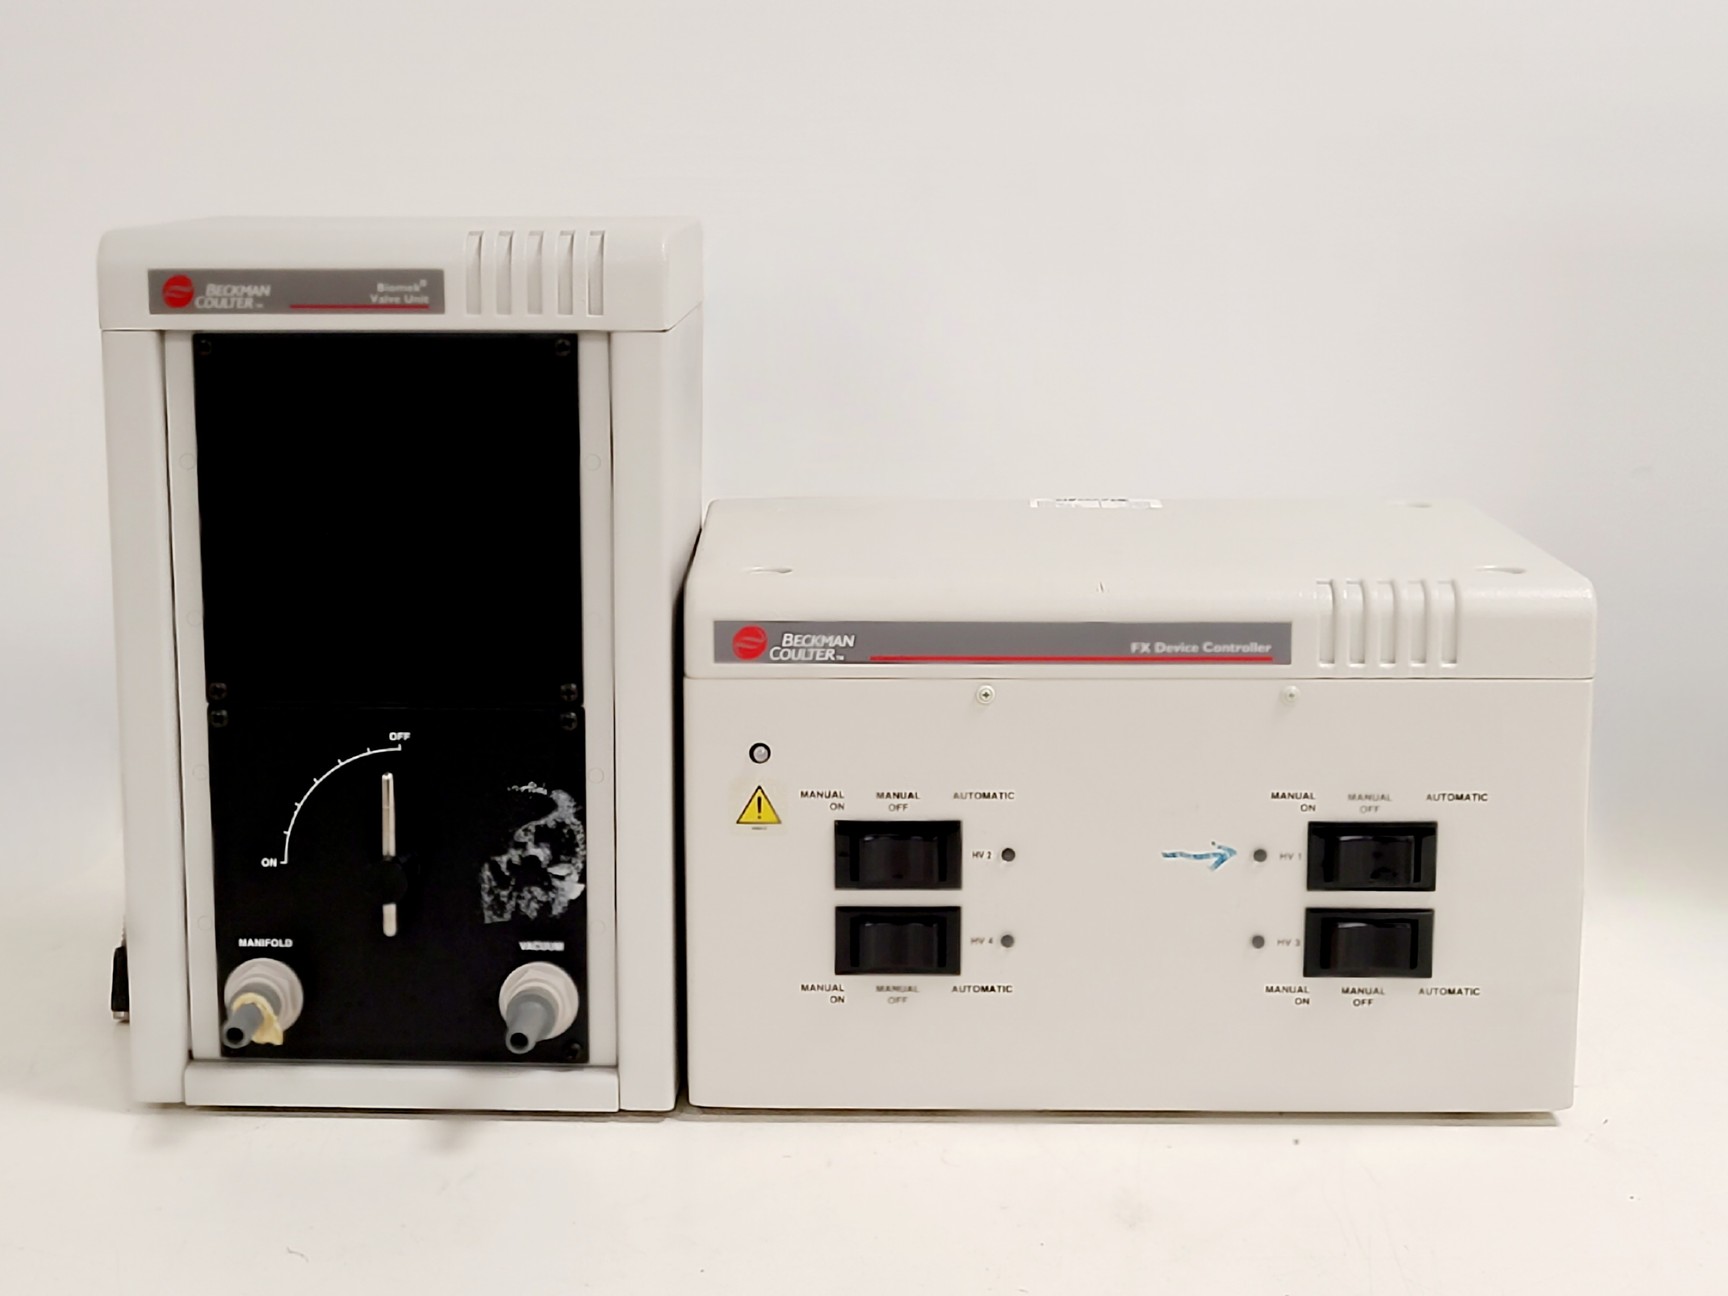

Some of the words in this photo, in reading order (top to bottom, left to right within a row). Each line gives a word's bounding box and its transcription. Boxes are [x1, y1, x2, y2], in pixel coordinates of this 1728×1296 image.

[205, 283, 271, 297] BECKMAN
[369, 294, 401, 304] Valve
[404, 294, 430, 305] Unit
[781, 633, 855, 647] BECKMAN
[1131, 642, 1151, 654] FX
[1154, 642, 1199, 653] Device
[1202, 641, 1272, 653] Controller
[388, 731, 411, 741] OFF
[800, 790, 845, 800] MANUAL
[876, 791, 920, 801] MANUAL
[952, 791, 1015, 800] AUTOMATIC
[1271, 791, 1316, 800] MANUAL
[1347, 793, 1392, 802] MANUAL
[1426, 792, 1488, 802] AUTOMATIC
[829, 802, 845, 811] ON
[887, 803, 909, 812] OFF
[1300, 803, 1316, 812] ON
[1359, 805, 1379, 814] OFF
[972, 851, 985, 860] HV
[986, 851, 992, 860] 2
[1279, 853, 1294, 861] HV
[260, 858, 278, 868] ON
[238, 938, 293, 948] MANIFOLD
[970, 937, 985, 945] HV
[987, 937, 993, 945] 4
[1276, 939, 1292, 947] HV
[1295, 939, 1301, 947] 3
[800, 983, 845, 993] MANUAL
[875, 984, 919, 994] MANUAL
[951, 985, 1013, 994] AUTOMATIC
[1265, 985, 1310, 994] MANUAL
[1341, 986, 1385, 996] MANUAL
[1418, 987, 1481, 997] AUTOMATIC
[829, 995, 845, 1004] ON
[887, 996, 909, 1005] OFF
[1294, 997, 1310, 1006] ON
[1352, 998, 1374, 1007] OFF
